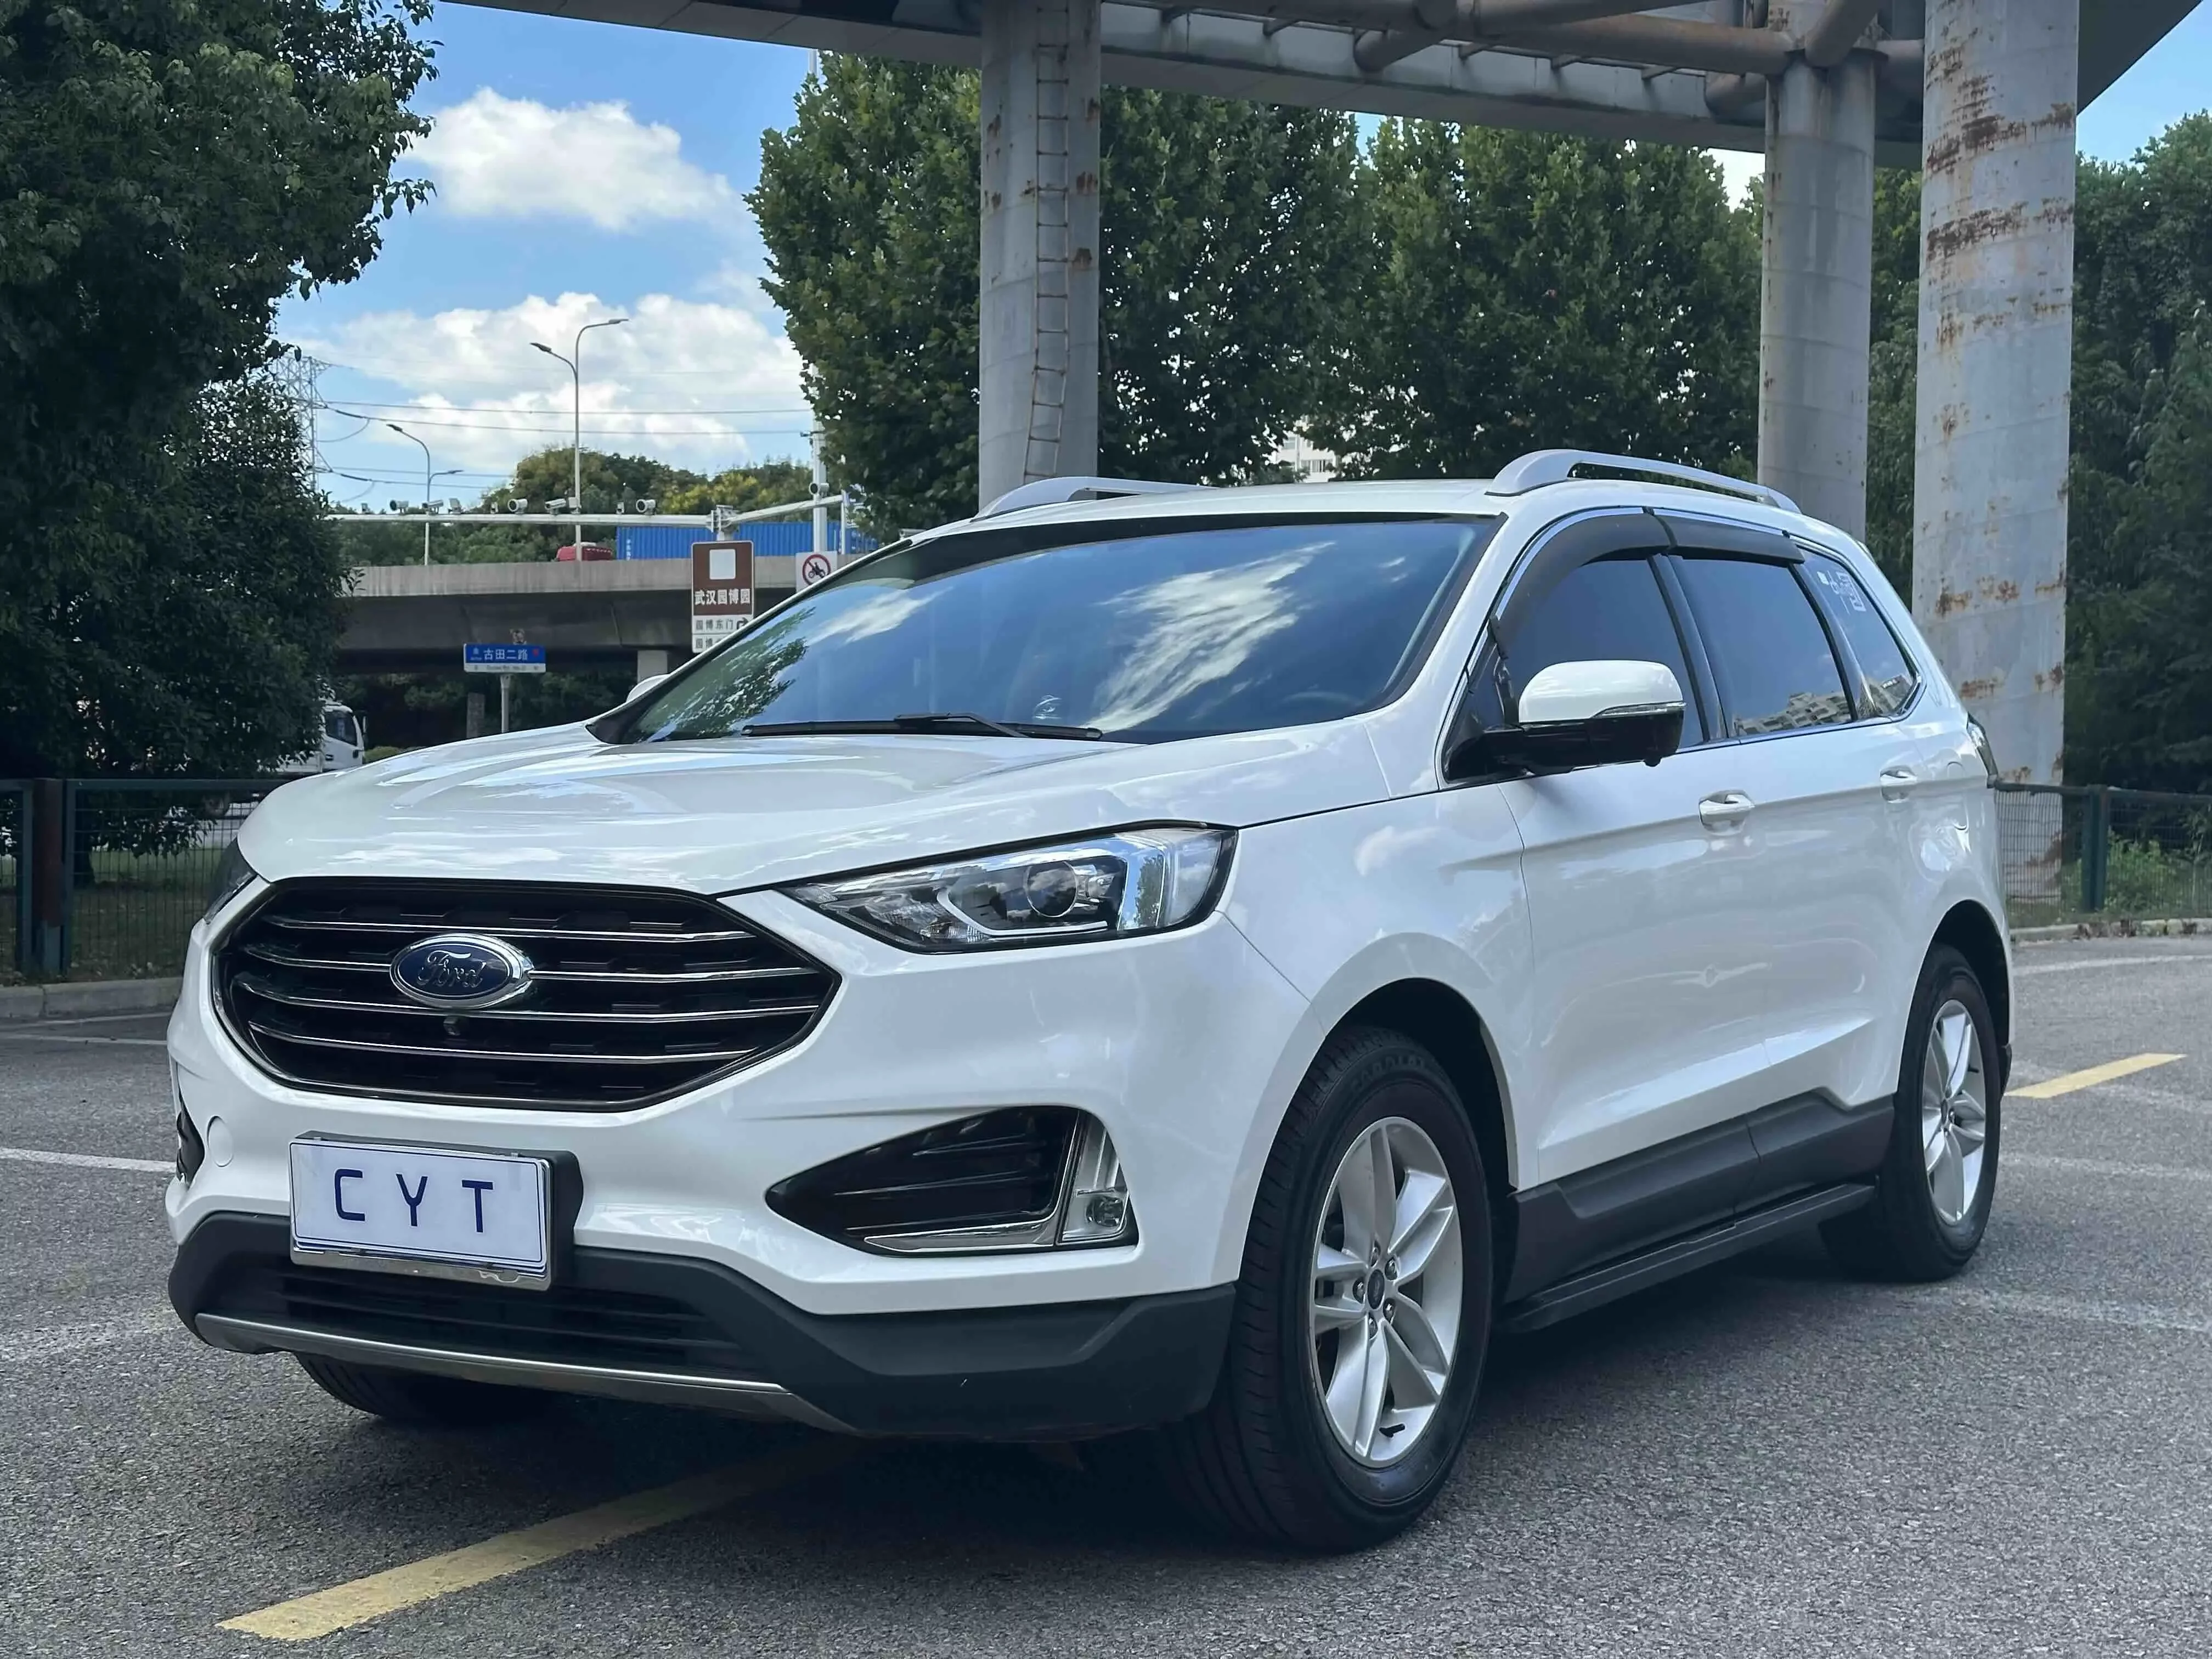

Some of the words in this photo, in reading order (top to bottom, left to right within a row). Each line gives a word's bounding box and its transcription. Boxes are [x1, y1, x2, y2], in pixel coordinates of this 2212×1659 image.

[695, 589, 751, 605] 武汉园博园
[696, 619, 733, 630] 园博东门
[696, 638, 721, 648] 园博
[483, 647, 528, 661] 古田二路
[417, 950, 487, 988] Ford
